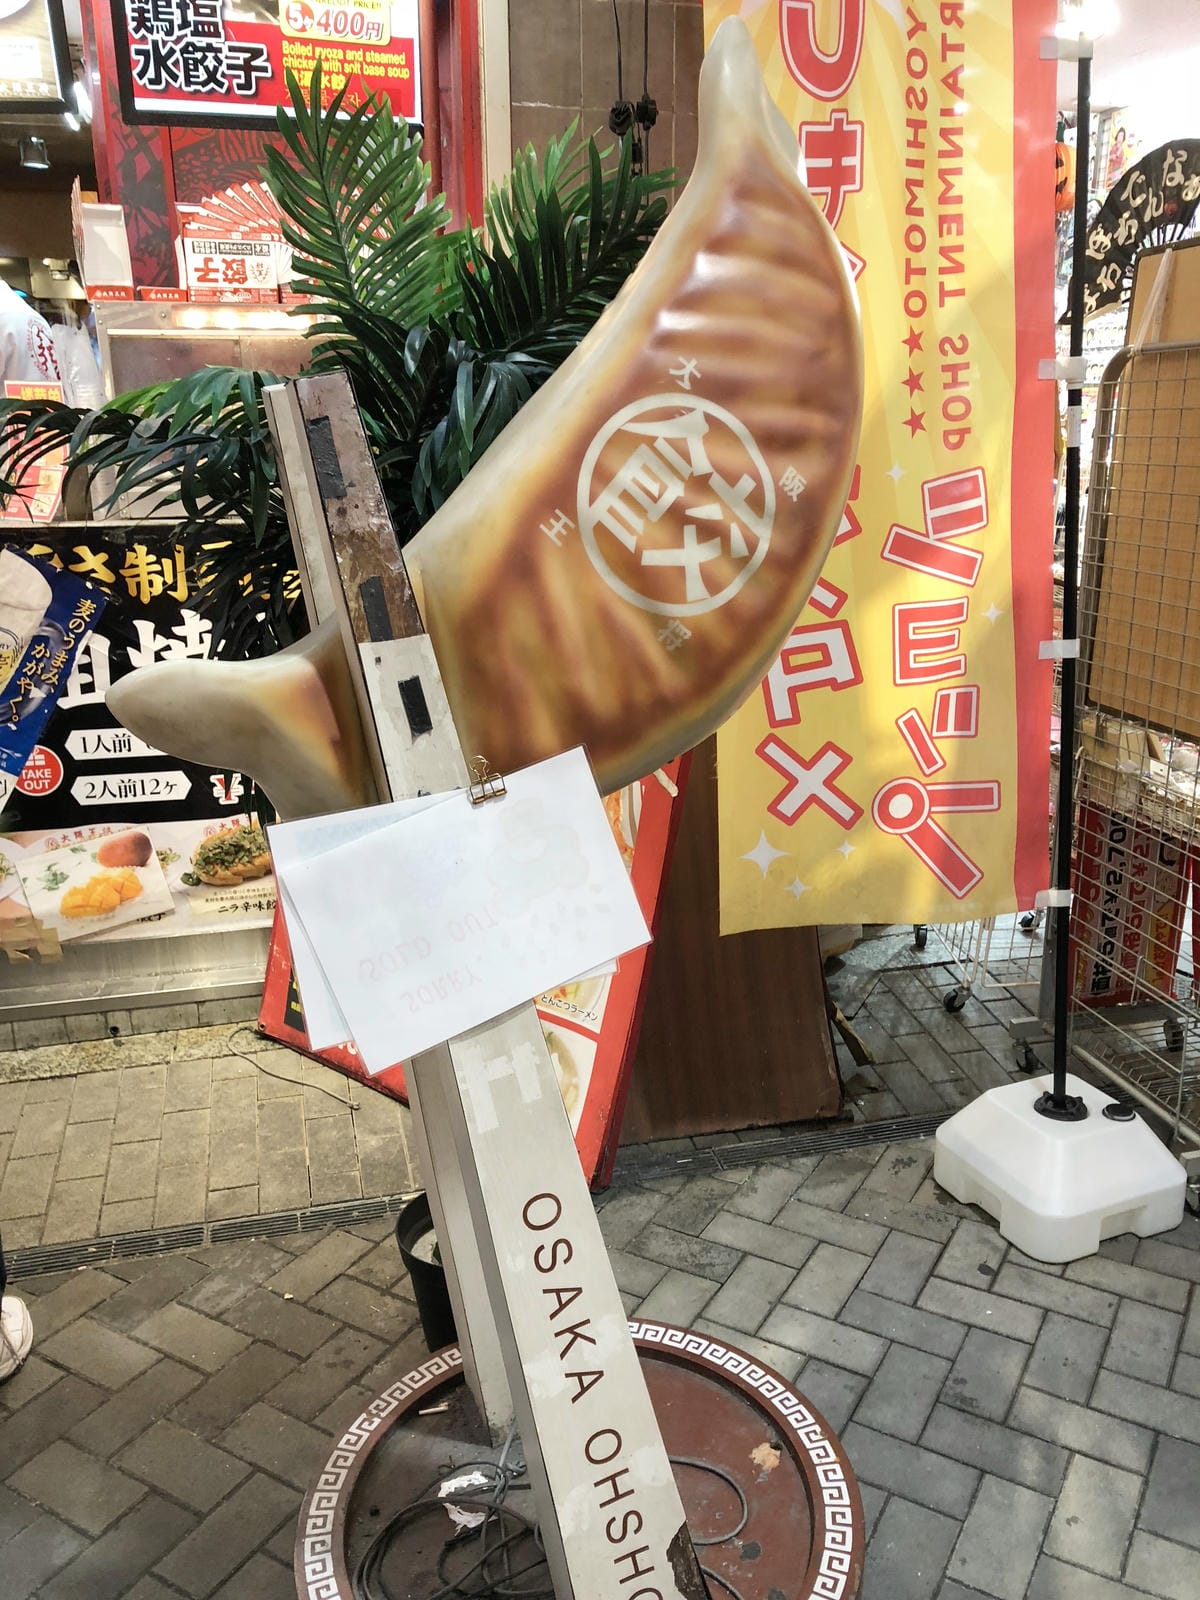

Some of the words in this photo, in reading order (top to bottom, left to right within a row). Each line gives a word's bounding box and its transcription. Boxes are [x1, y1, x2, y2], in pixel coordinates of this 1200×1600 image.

[130, 0, 222, 38] 鶏塩
[316, 8, 385, 38] 400円
[133, 40, 271, 92] 水餃子
[282, 40, 313, 57] Boiled
[345, 48, 364, 61] and
[365, 50, 406, 65] steamed
[321, 59, 342, 74] with
[362, 63, 386, 77] base
[387, 66, 410, 80] soup
[193, 256, 248, 285] 餃子
[22, 767, 52, 780] TAKE
[23, 779, 51, 791] OUT
[541, 994, 599, 1021] とんこつラーメン
[522, 1192, 605, 1404] OSAKA
